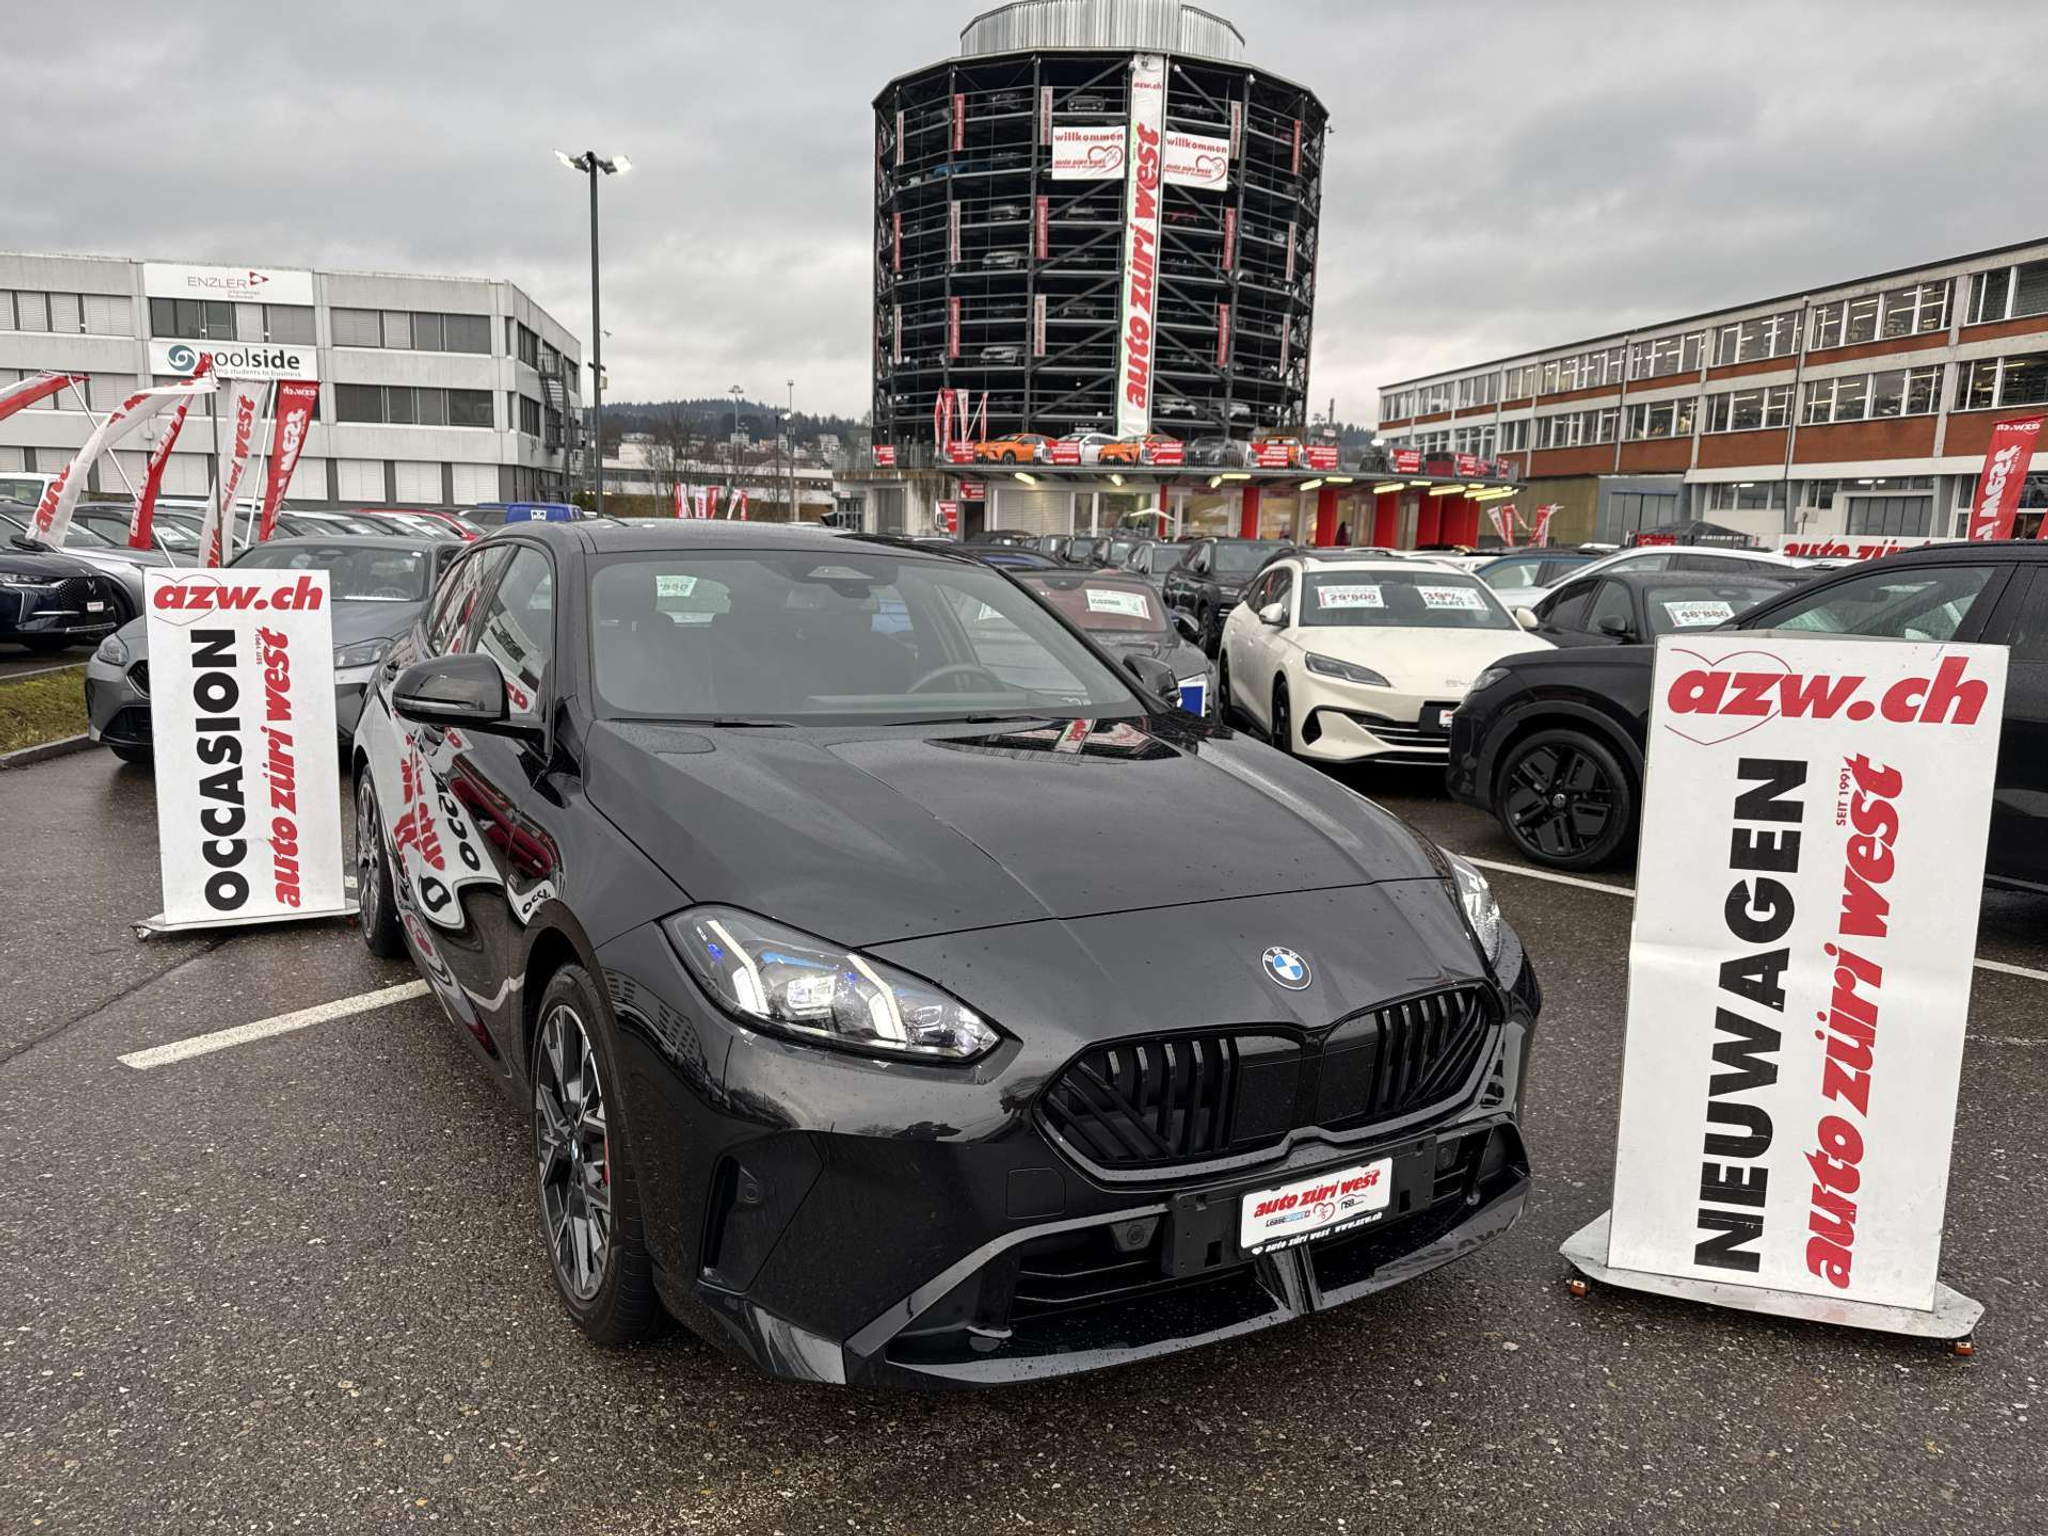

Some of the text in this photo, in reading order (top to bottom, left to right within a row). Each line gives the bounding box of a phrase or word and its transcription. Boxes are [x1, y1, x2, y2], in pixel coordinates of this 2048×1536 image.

[1134, 82, 1162, 90] azw.ch
[1055, 131, 1124, 142] willkommen
[1166, 137, 1228, 154] willkommen
[187, 276, 248, 290] ENZLER
[1126, 122, 1160, 410] auto züri west
[208, 347, 301, 370] oolside
[235, 393, 255, 459] west
[153, 576, 323, 611] azw.ch
[255, 650, 263, 665] SEIT
[1666, 656, 1989, 726] azw.ch
[190, 628, 250, 912] OCCASION
[259, 626, 302, 908] auto züri west
[1835, 766, 1851, 827] SEIT 1991
[1693, 757, 1808, 1274] NEUWAGEN
[1804, 753, 1904, 1289] auto züri west
[1254, 1170, 1382, 1218] auto züri west
[1265, 1240, 1287, 1253] auto
[1310, 1228, 1331, 1240] west
[1334, 1211, 1383, 1233] www.azw.ch
